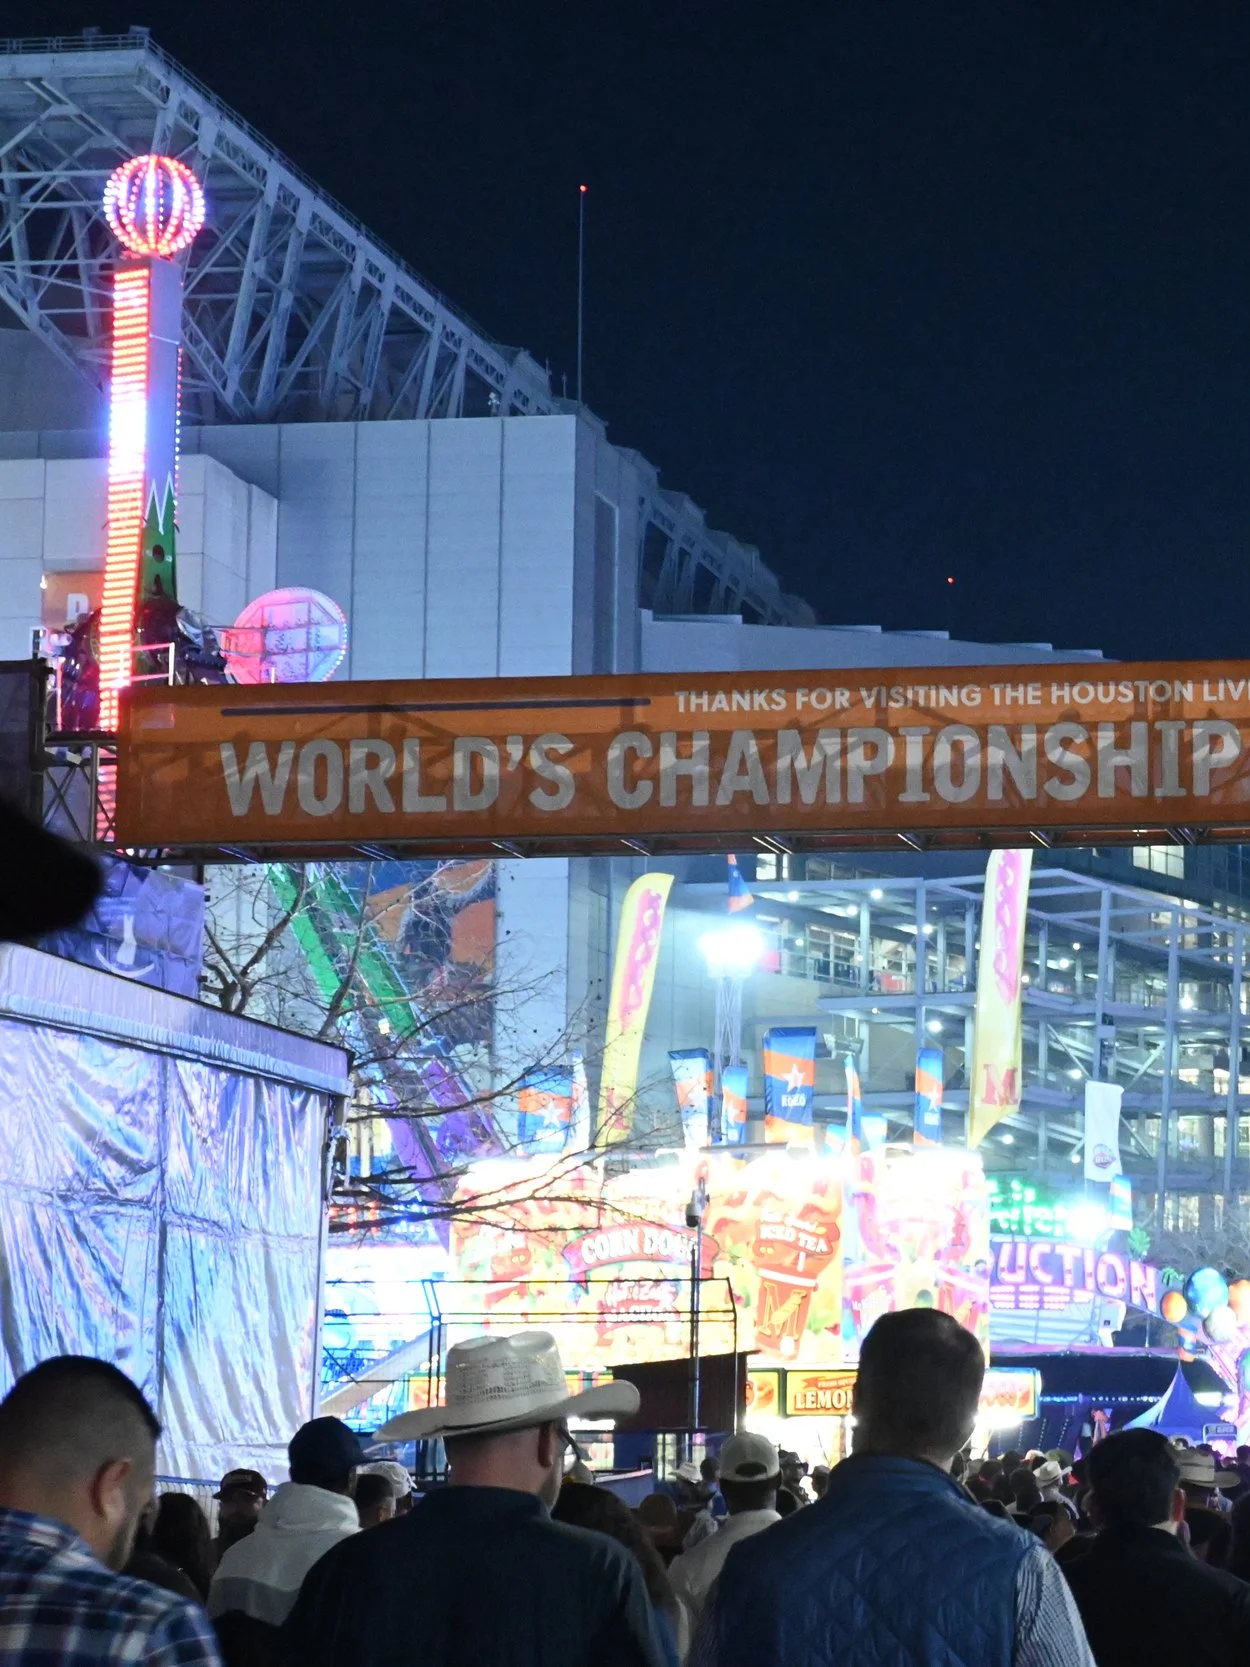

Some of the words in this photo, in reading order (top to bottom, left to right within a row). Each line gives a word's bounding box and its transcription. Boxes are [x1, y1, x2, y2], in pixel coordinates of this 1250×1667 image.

[675, 688, 786, 714] THANKS
[796, 687, 850, 711] FOR
[859, 683, 987, 709] VISITING
[993, 682, 1042, 706] THE
[1051, 680, 1194, 705] HOUSTON
[220, 733, 576, 816] WORLD'S
[606, 719, 1241, 810] CHAMPIONSHIP
[798, 1231, 829, 1252] TEA
[989, 1243, 1157, 1312] UCTION
